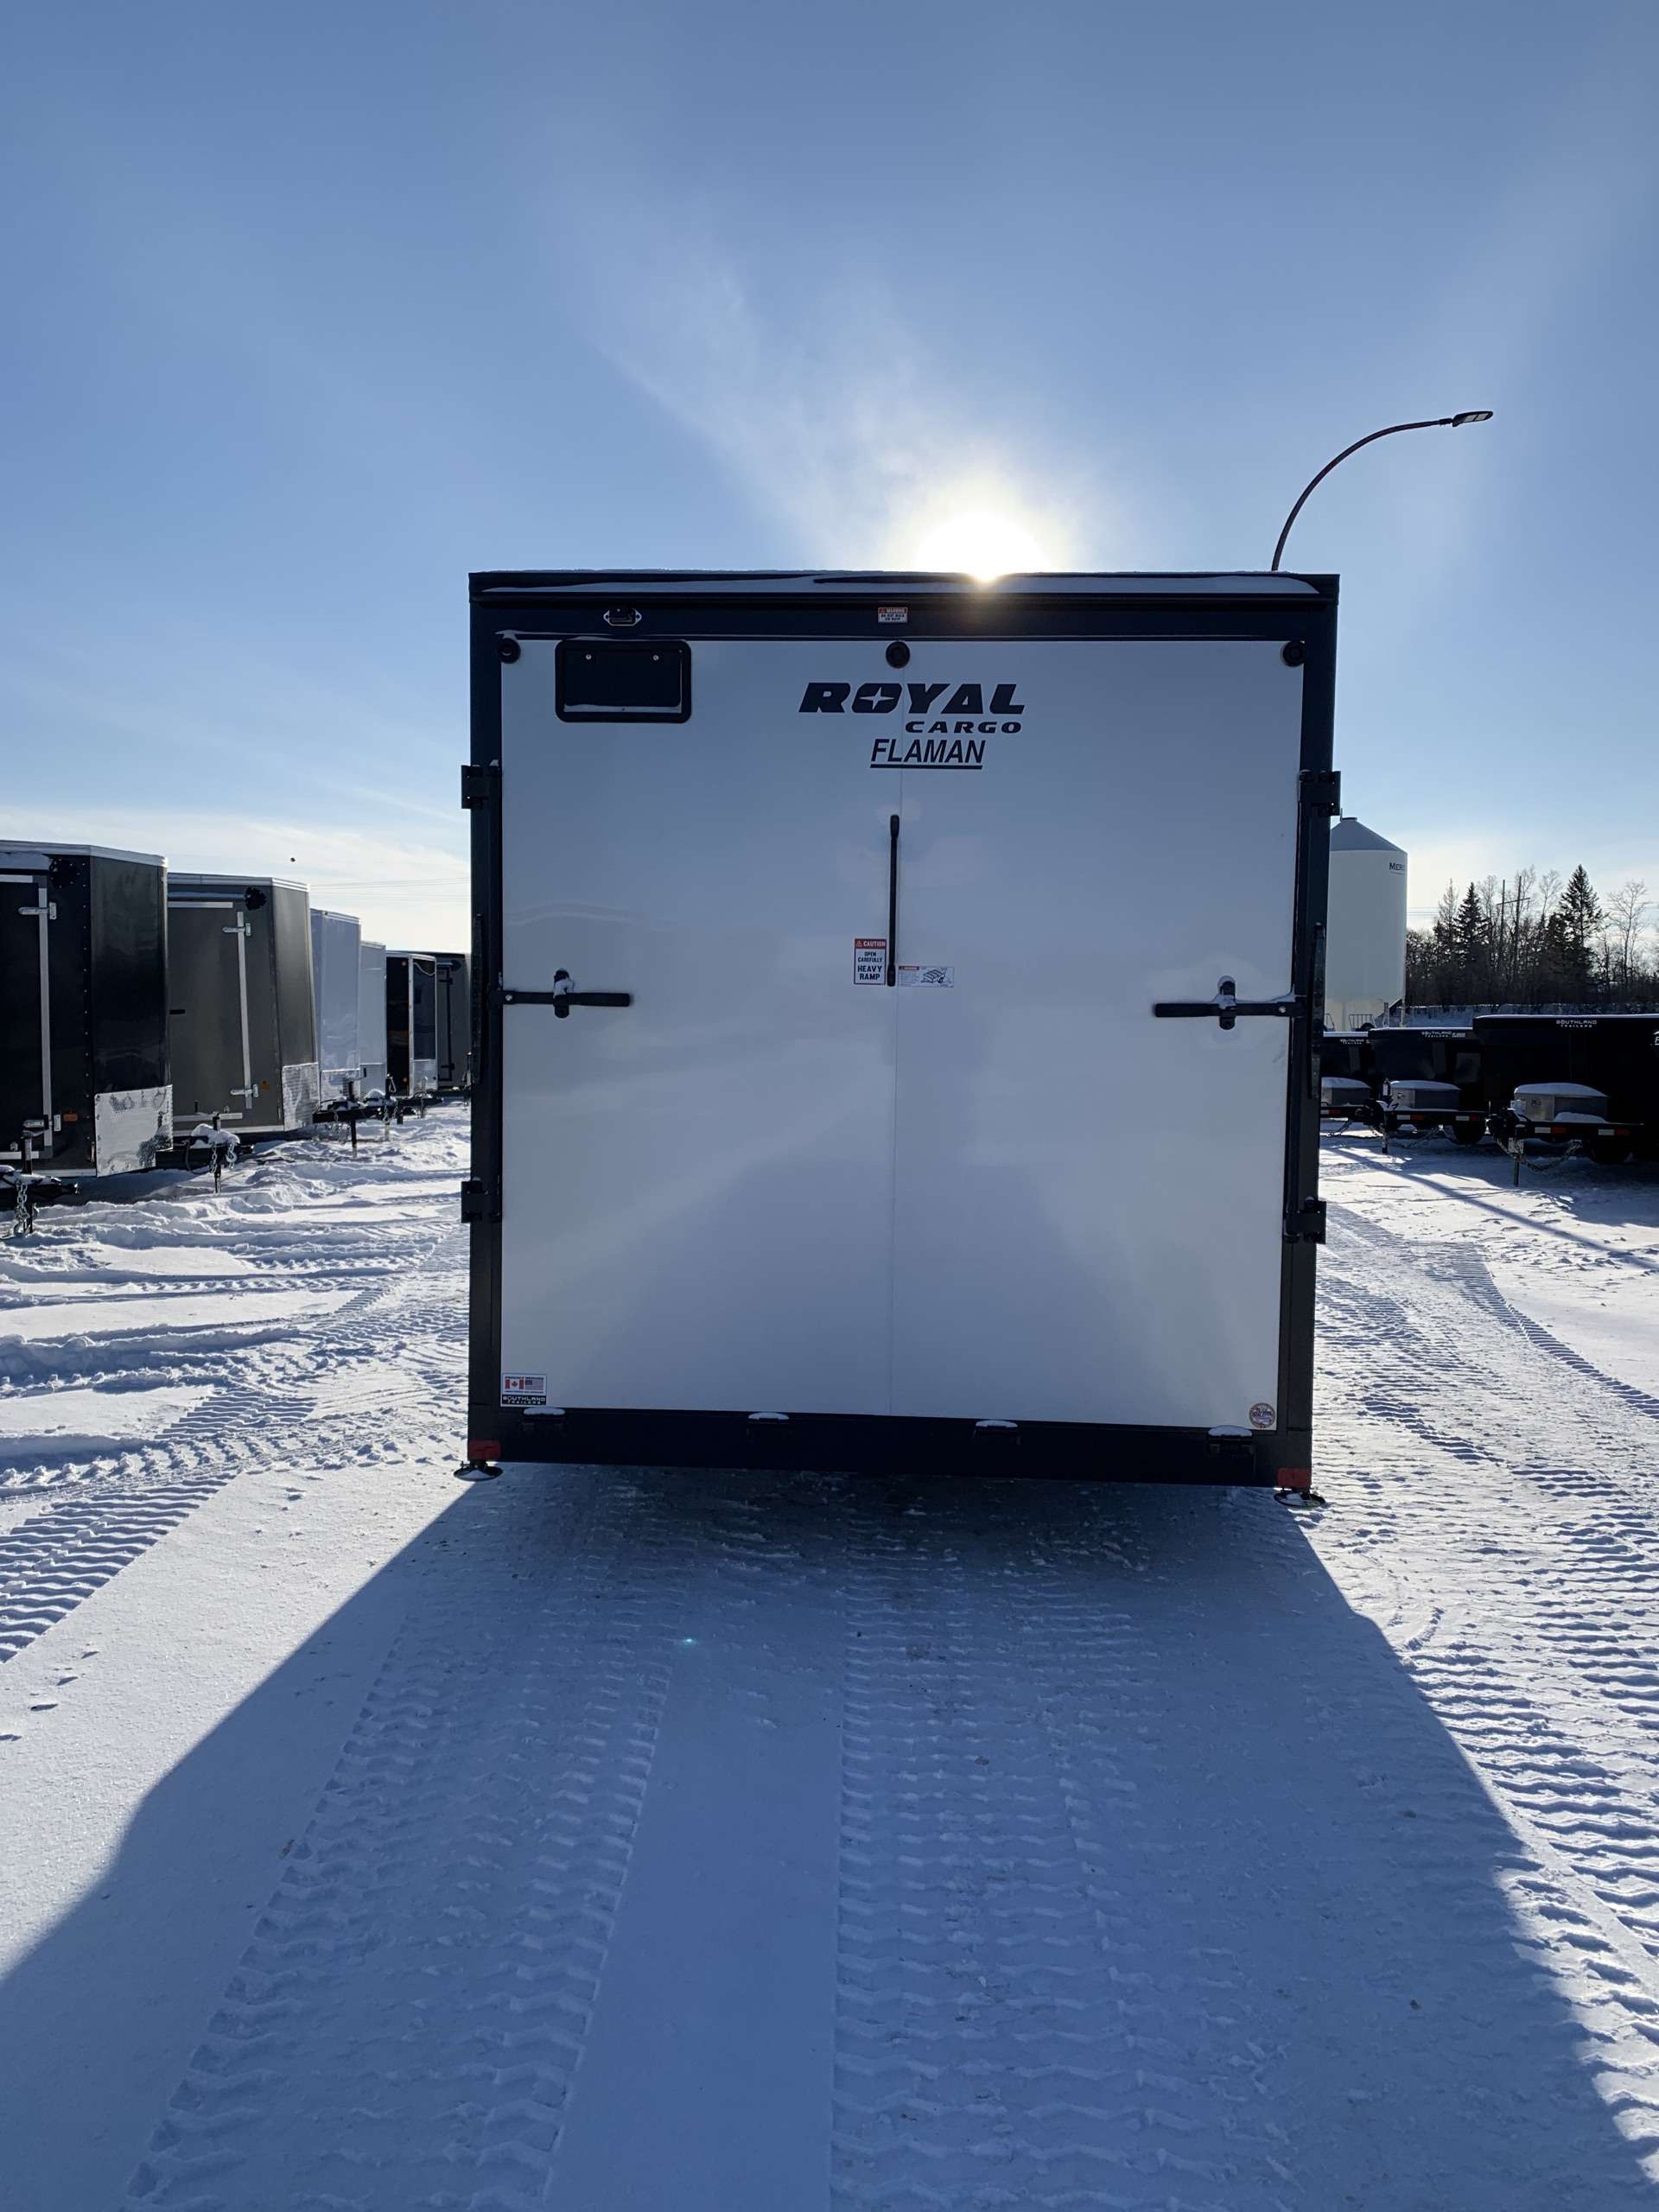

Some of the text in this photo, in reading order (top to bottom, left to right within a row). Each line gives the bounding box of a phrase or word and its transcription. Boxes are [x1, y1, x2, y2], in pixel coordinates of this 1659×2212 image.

[798, 682, 1025, 715] ROYAL
[905, 721, 1022, 734] CARGO
[870, 738, 986, 763] FLAMAN
